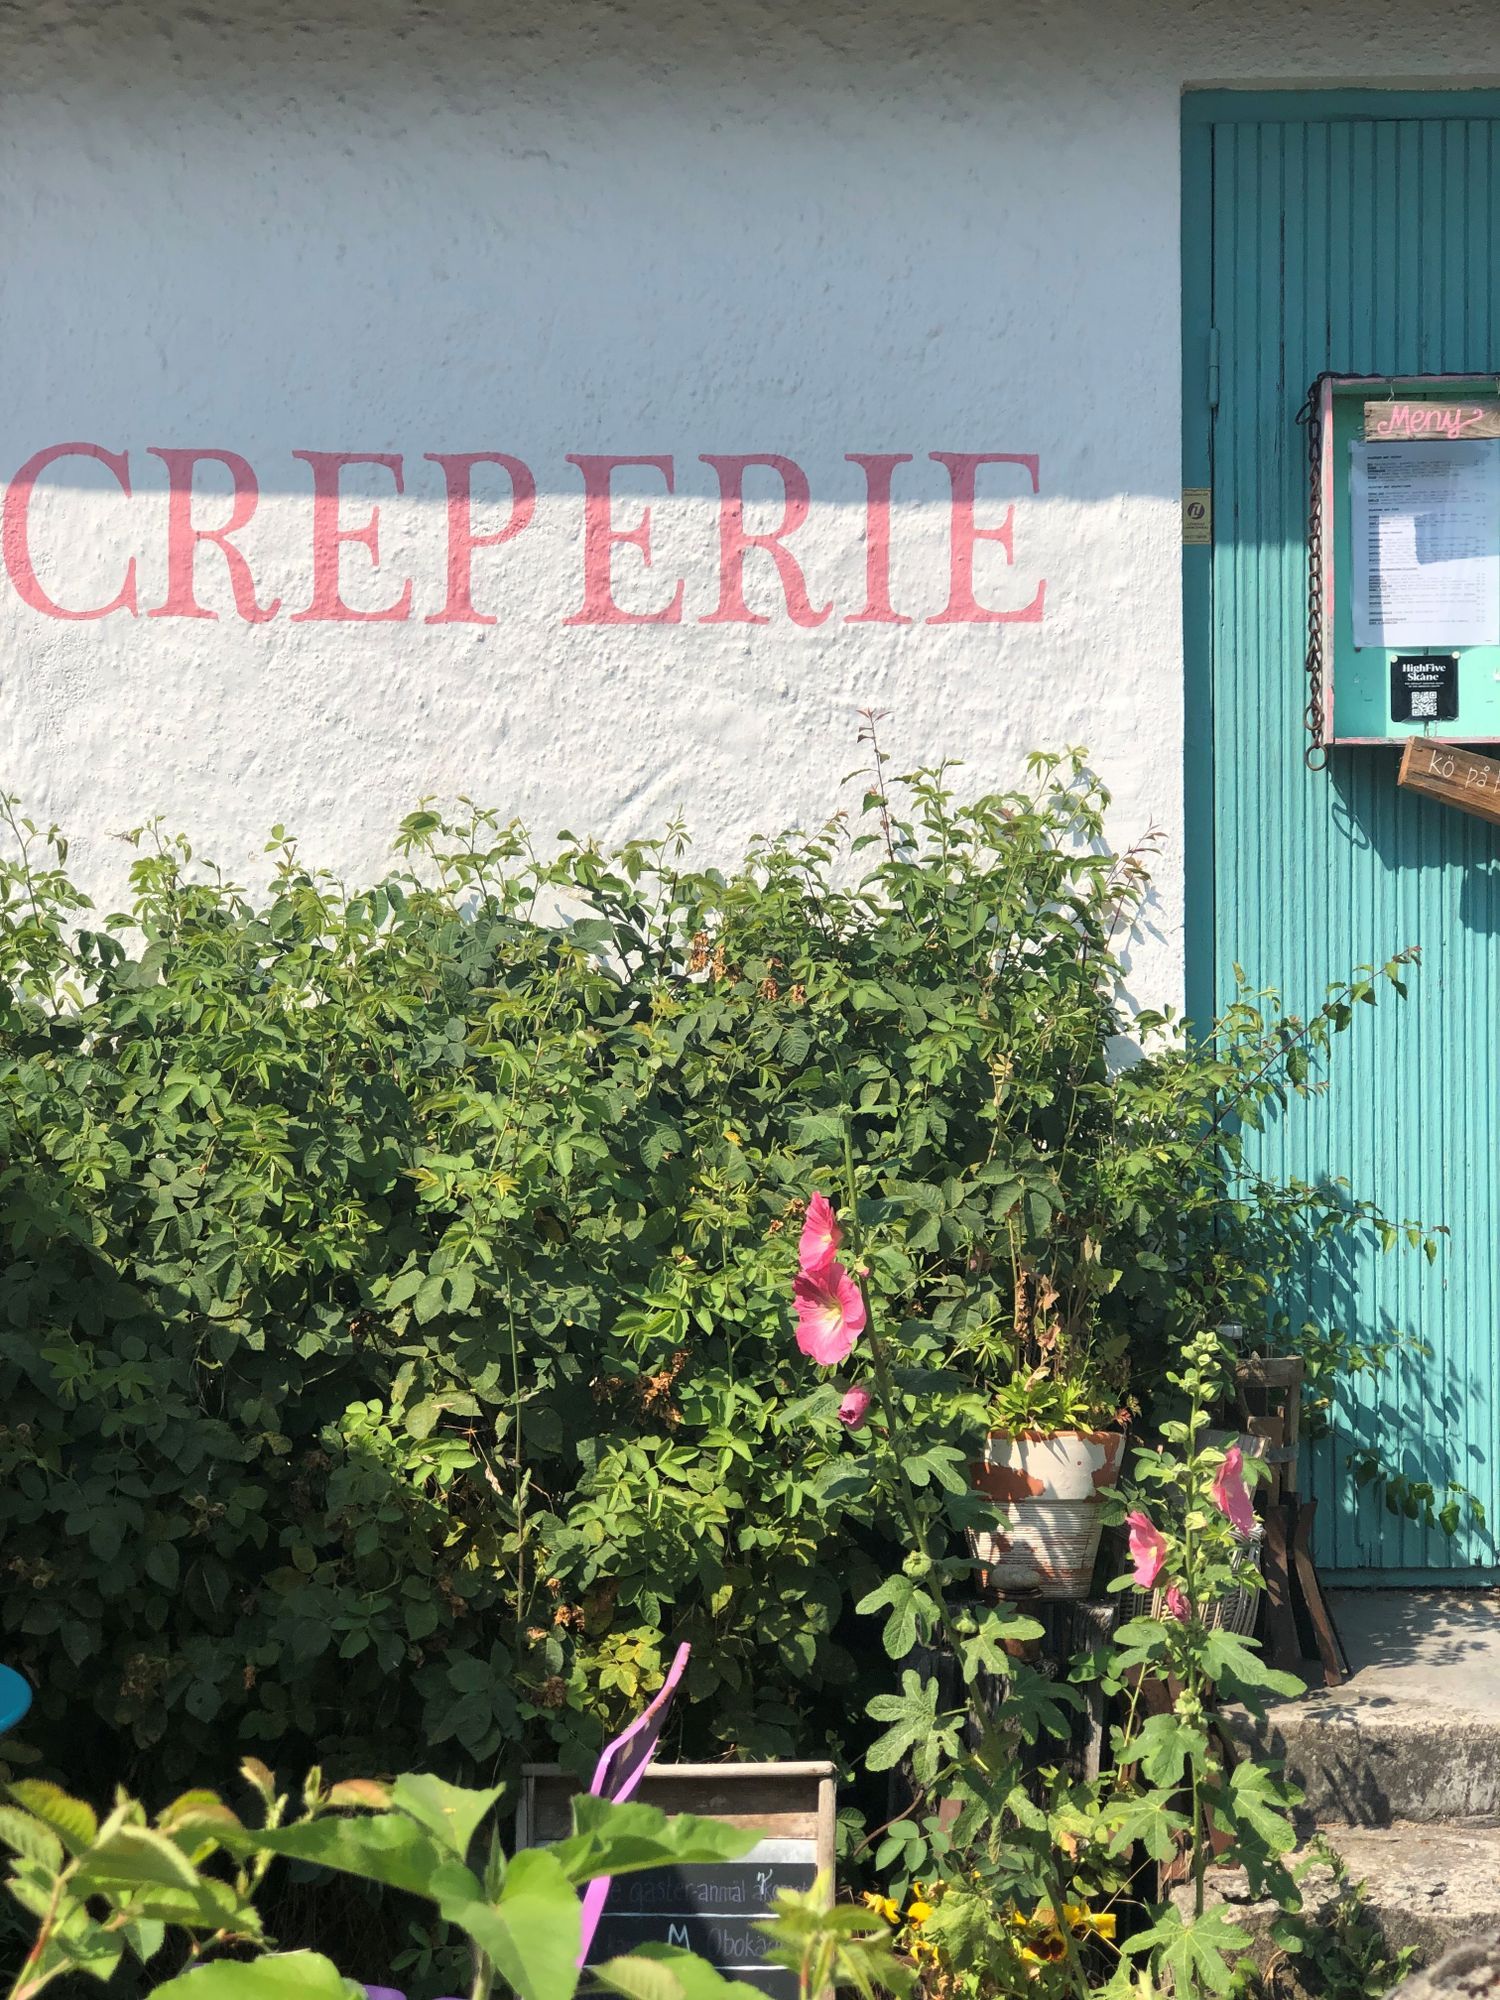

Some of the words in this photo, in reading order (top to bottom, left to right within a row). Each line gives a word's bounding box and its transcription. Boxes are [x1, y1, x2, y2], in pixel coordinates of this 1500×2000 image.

[1377, 405, 1484, 439] Meny
[4, 442, 1047, 627] CREPERIE
[1402, 663, 1447, 673] HighFive
[1407, 672, 1440, 681] Skåne
[1465, 765, 1491, 788] på
